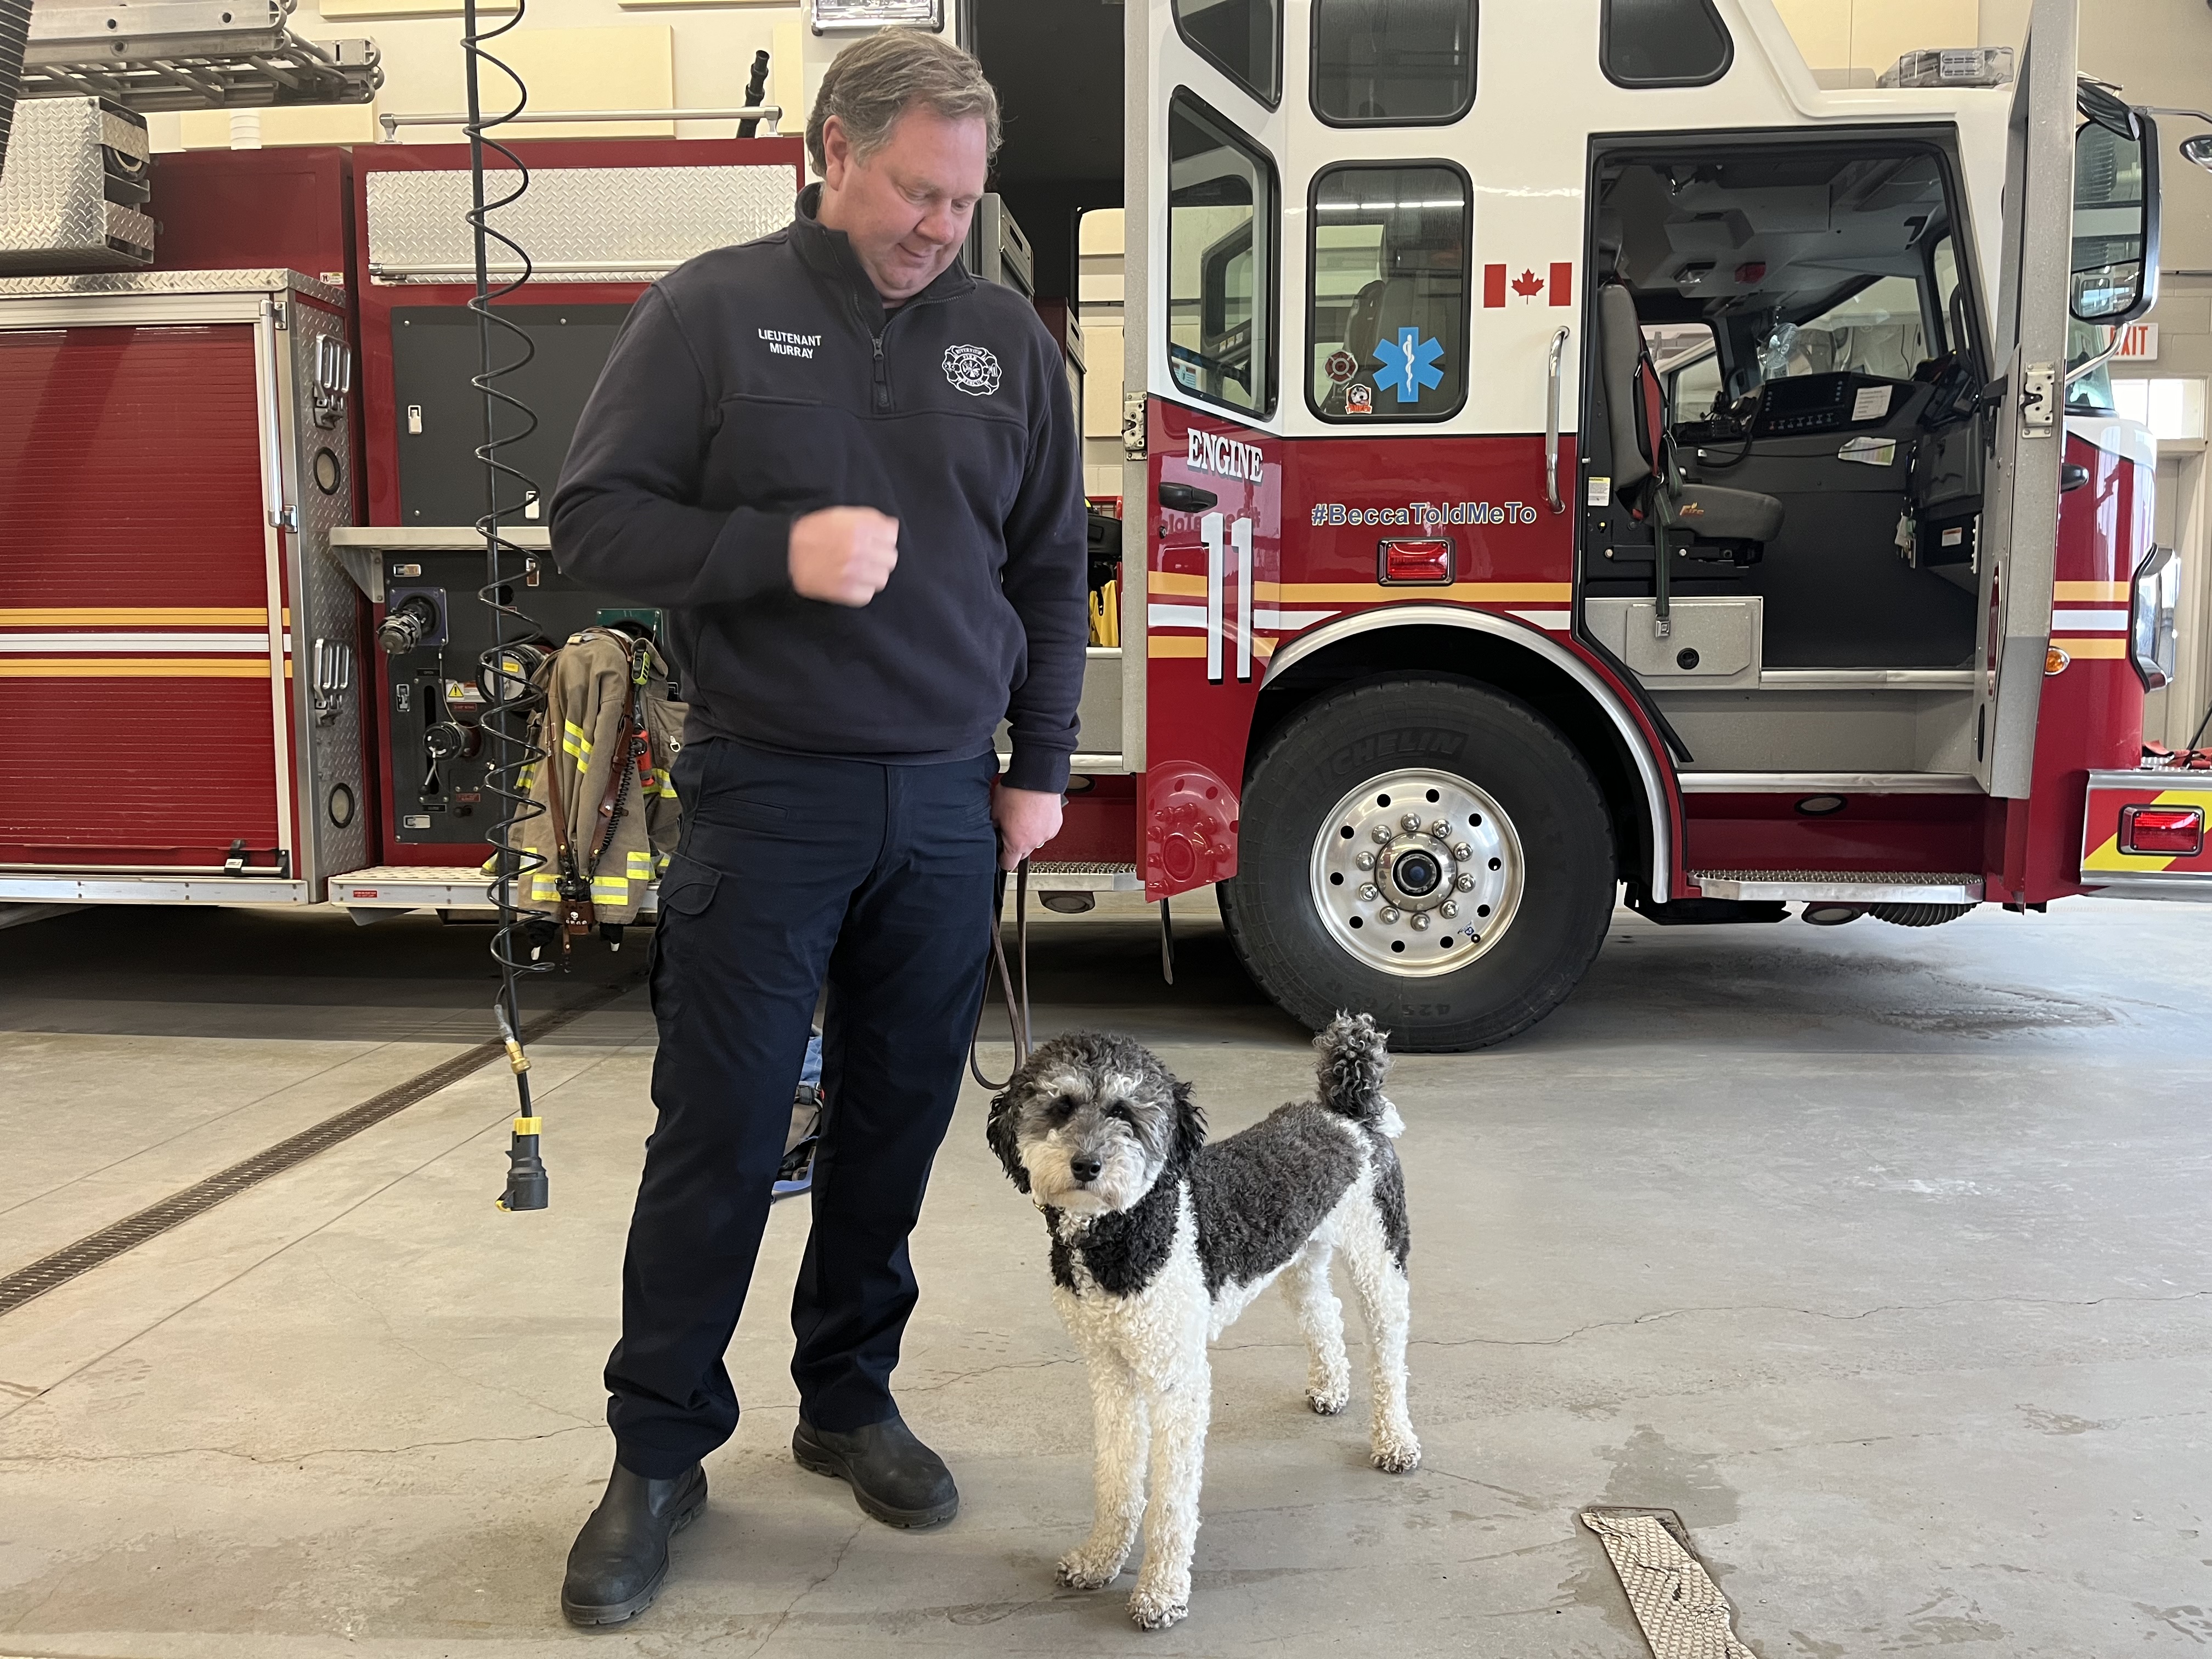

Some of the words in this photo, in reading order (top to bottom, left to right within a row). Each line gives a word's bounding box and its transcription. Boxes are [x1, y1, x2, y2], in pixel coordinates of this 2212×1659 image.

[758, 328, 822, 347] LIEUTENANT
[769, 342, 814, 359] MURRAY
[1187, 427, 1263, 483] ENGINE
[1311, 501, 1537, 526] #BeccaToldMeTo
[1201, 511, 1252, 680] 11
